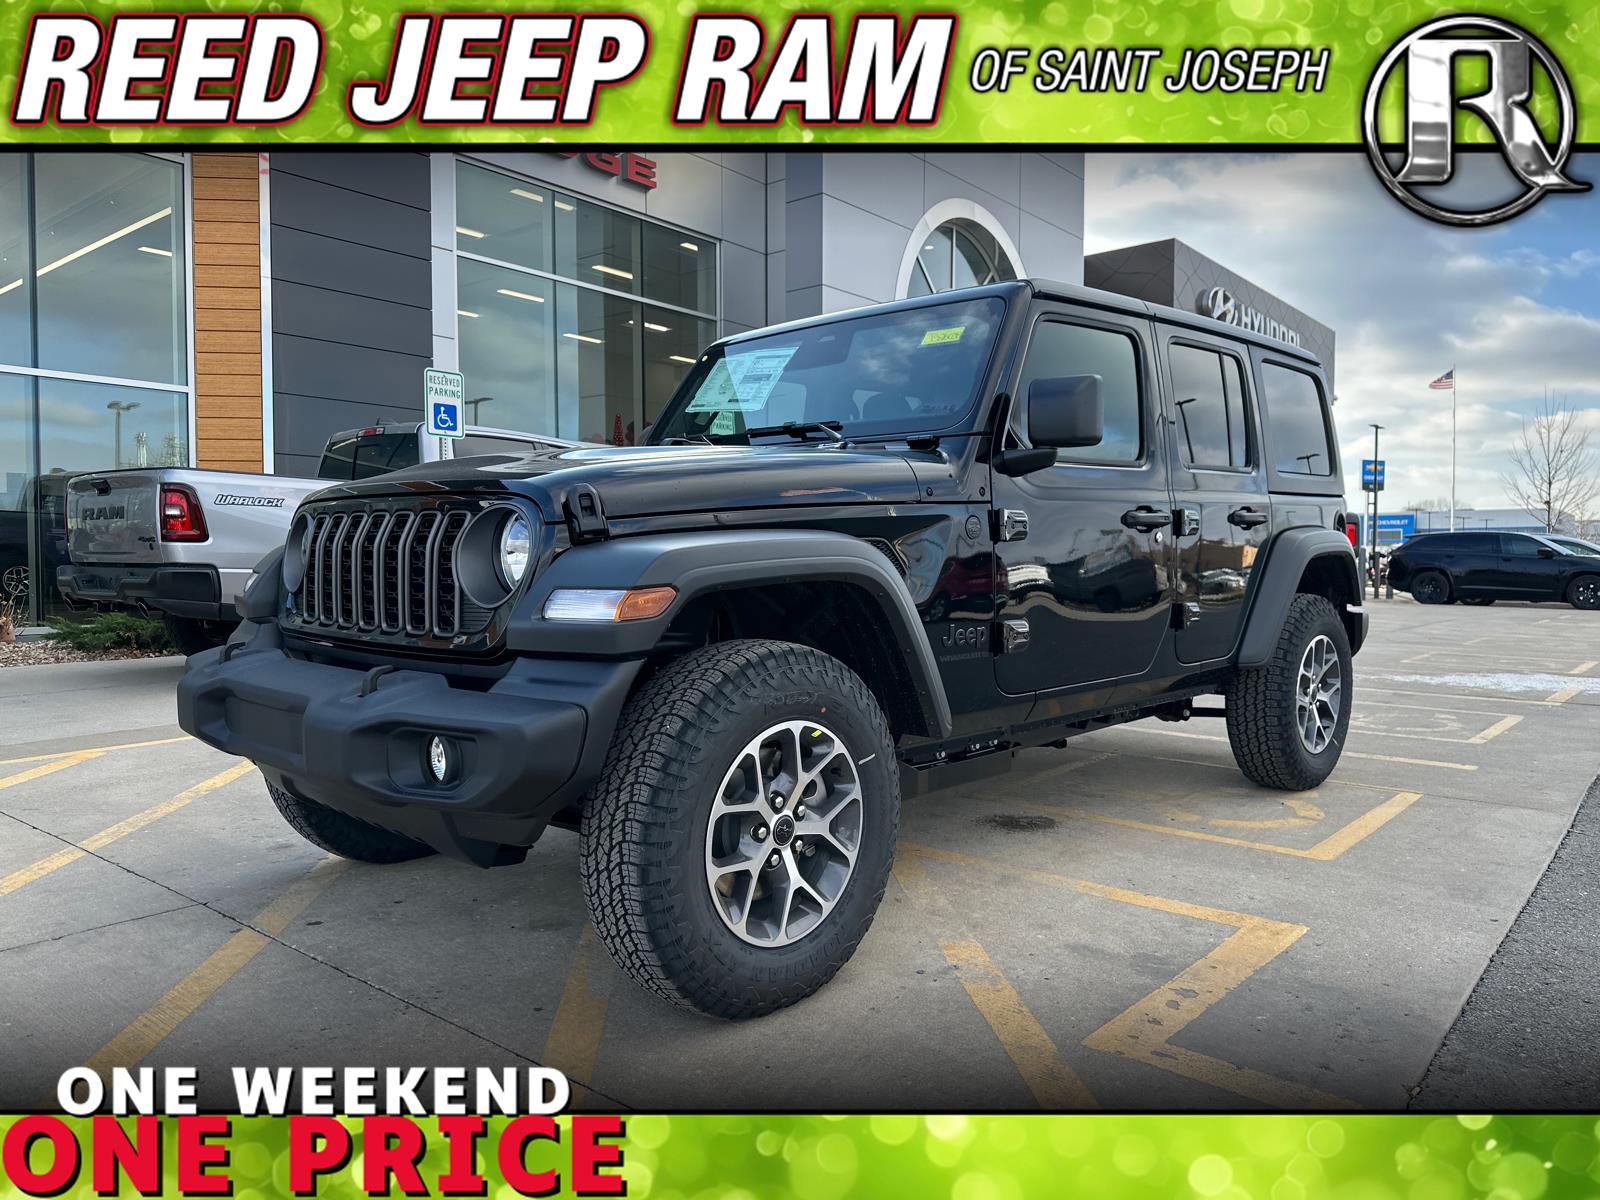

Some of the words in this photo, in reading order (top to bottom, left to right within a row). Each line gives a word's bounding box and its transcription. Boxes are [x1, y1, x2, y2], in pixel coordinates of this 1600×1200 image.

[428, 375, 461, 388] RESERVED
[428, 386, 461, 399] PARKING
[214, 494, 285, 507] WARLOCK
[82, 506, 125, 520] RAM
[942, 623, 988, 648] Jeep
